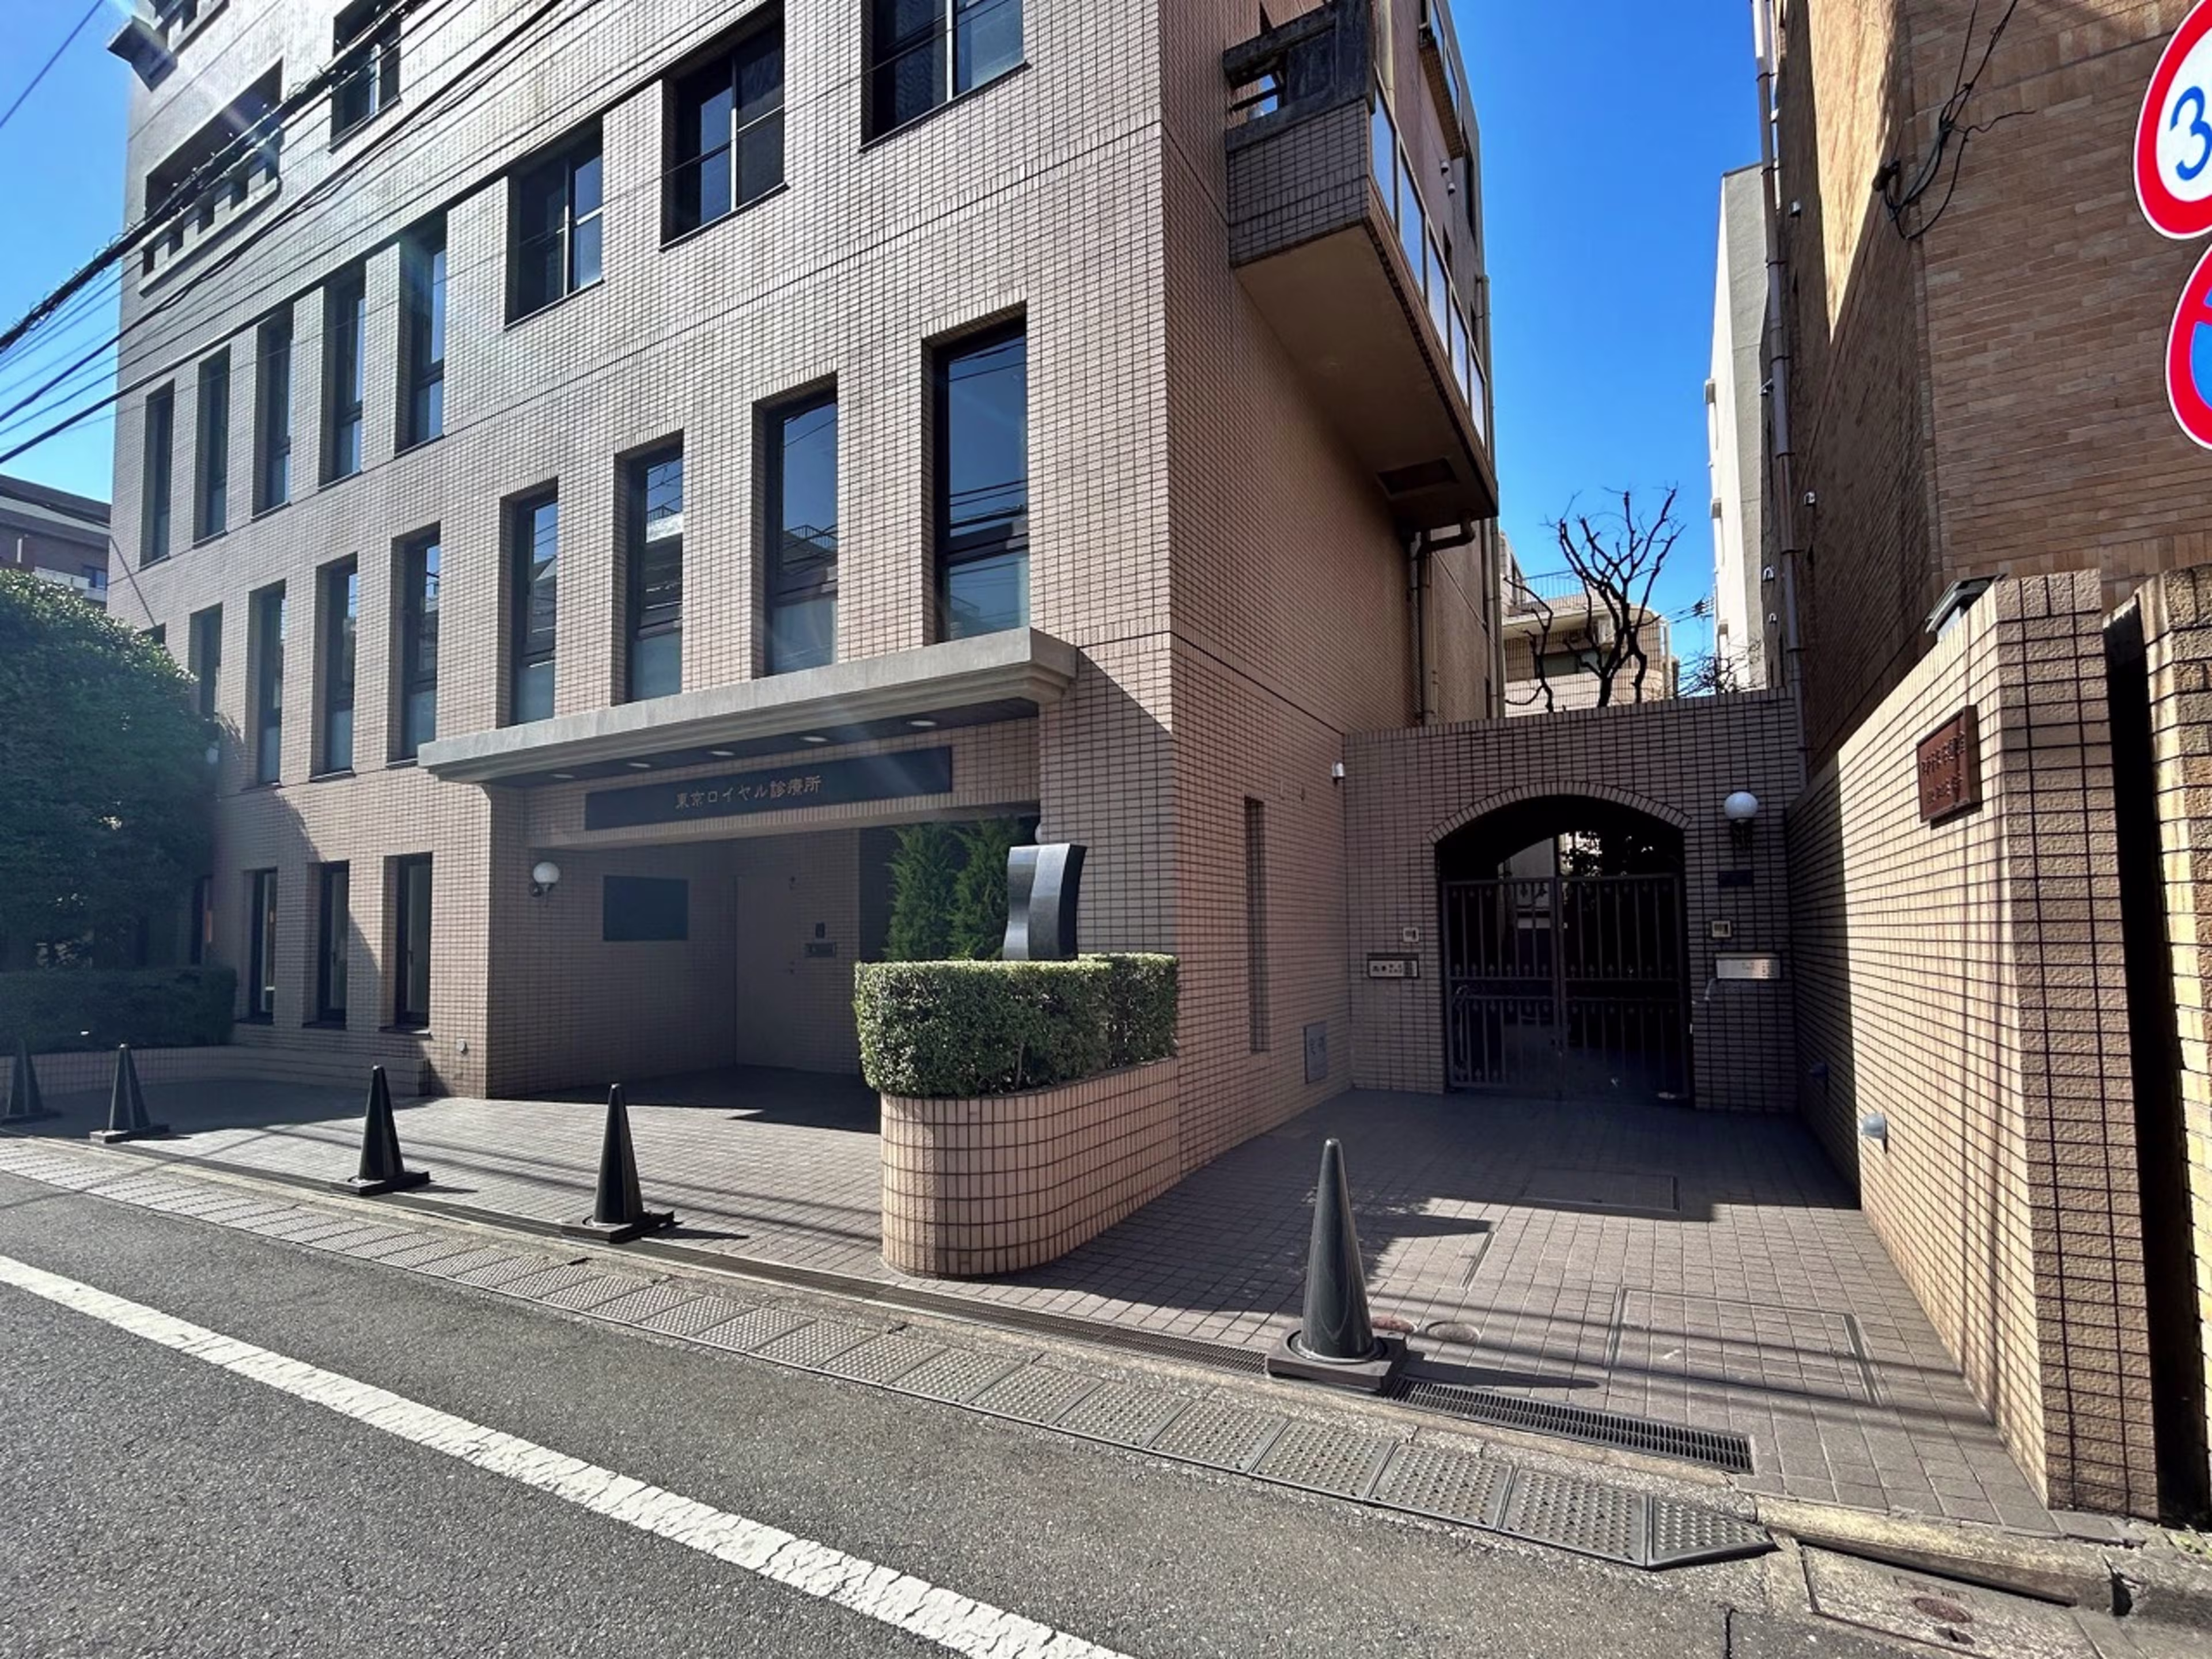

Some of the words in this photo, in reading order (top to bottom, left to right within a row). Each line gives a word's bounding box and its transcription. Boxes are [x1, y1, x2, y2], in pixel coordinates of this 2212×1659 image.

[2169, 86, 2212, 181] 3
[676, 775, 821, 809] 東京ロイヤル診療所
